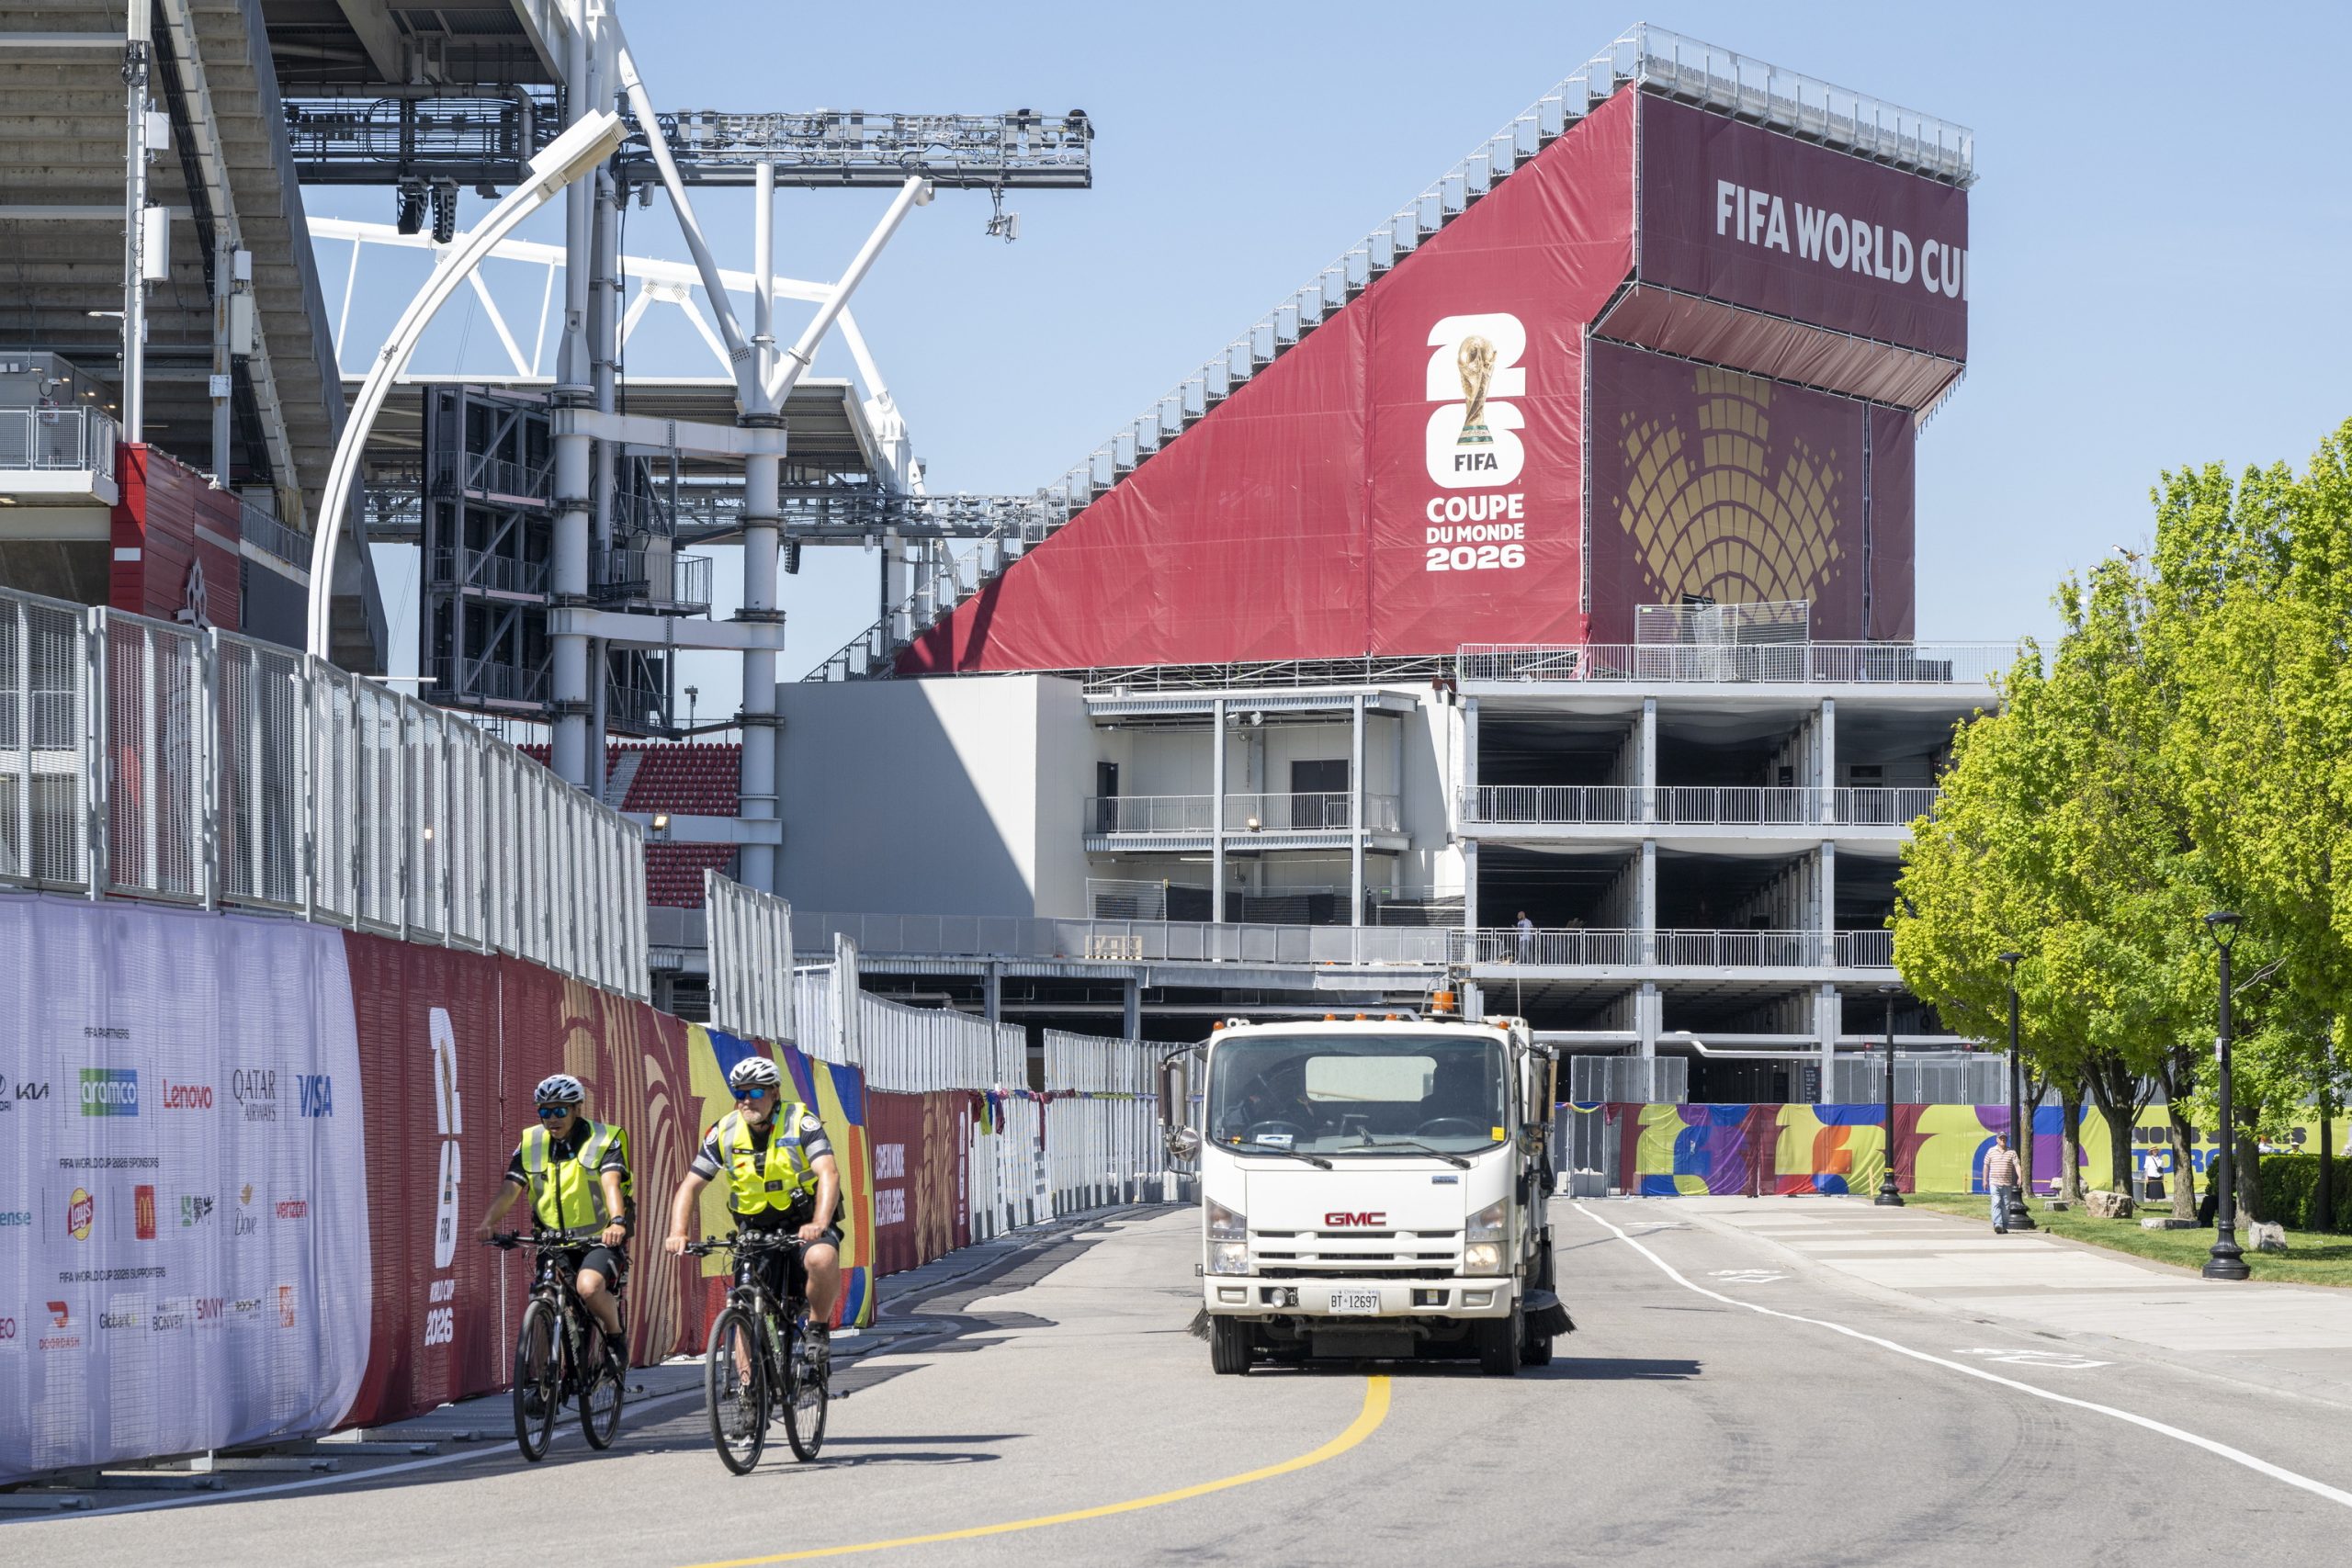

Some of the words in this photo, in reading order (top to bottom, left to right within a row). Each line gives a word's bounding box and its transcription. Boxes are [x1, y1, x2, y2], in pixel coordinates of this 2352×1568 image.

[1716, 179, 1790, 254] FIFA
[1794, 202, 1915, 284] WORLD
[1454, 453, 1498, 471] FIFA
[1426, 493, 1525, 524] COUPE
[1426, 526, 1455, 544] DU
[1456, 523, 1525, 542] MONDE
[1426, 544, 1526, 571] 2026
[85, 1027, 97, 1038] FIFA
[98, 1027, 130, 1039] PARTNERS
[82, 1081, 137, 1104] aramco
[163, 1078, 212, 1109] Lenovo
[232, 1069, 276, 1106] QATAR
[296, 1075, 333, 1118] VISA
[243, 1104, 276, 1122] AIRWAYS
[60, 1158, 74, 1169] FIFA
[75, 1157, 97, 1169] WORLD
[99, 1157, 111, 1169] CUP
[112, 1157, 128, 1168] 2026
[129, 1157, 159, 1168] SPONSORS
[276, 1199, 308, 1219] verizon
[1325, 1212, 1386, 1227] GMC
[235, 1207, 257, 1235] Dove
[439, 1218, 451, 1244] FIFA
[59, 1271, 74, 1283] FIFA
[74, 1270, 98, 1283] WORLD
[99, 1269, 112, 1281] CUP
[113, 1269, 130, 1280] 2026
[130, 1267, 165, 1280] SUPPORTERS
[443, 1280, 455, 1302] CUP
[1331, 1295, 1342, 1308] BT
[1350, 1295, 1377, 1308] 12697
[424, 1306, 454, 1347] 2026
